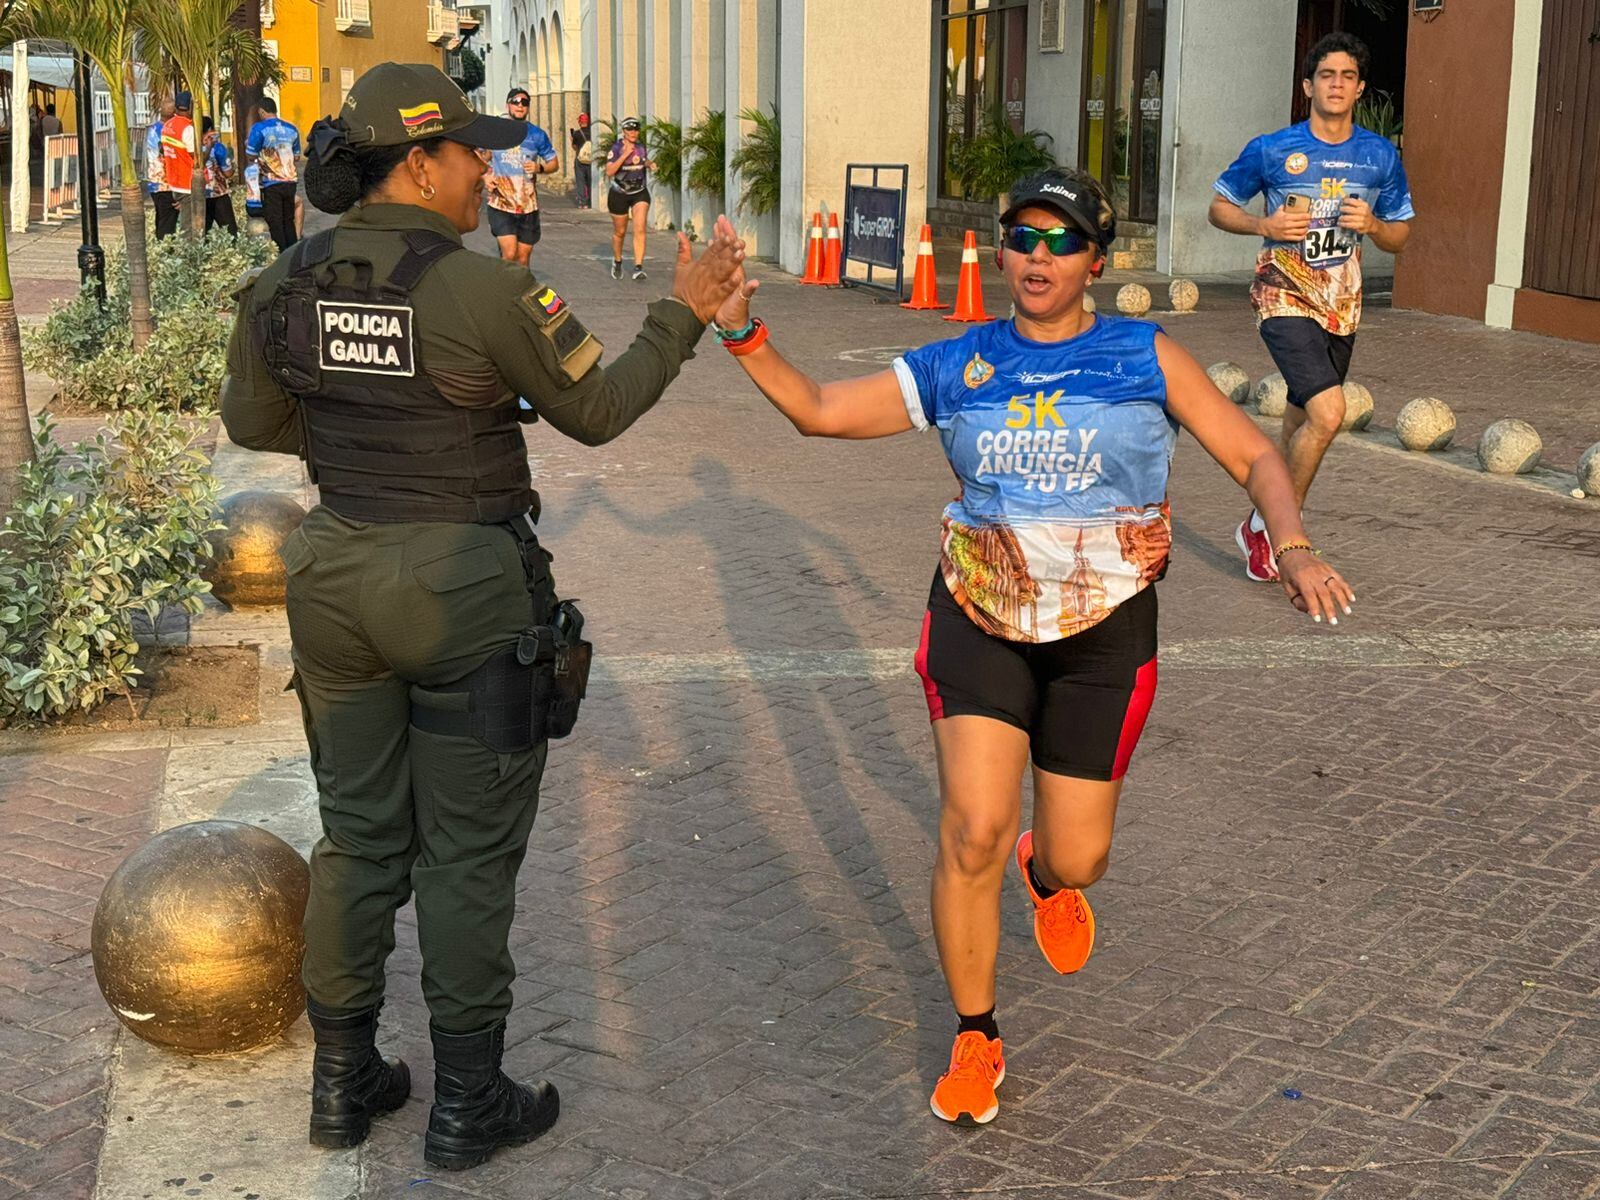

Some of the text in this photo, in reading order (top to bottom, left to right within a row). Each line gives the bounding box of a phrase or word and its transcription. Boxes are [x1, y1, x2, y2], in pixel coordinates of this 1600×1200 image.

[1039, 183, 1077, 201] Selina
[1320, 177, 1348, 199] 5K
[324, 312, 403, 338] POLICIA
[330, 339, 400, 366] GAULA
[1004, 390, 1067, 429] 5K
[976, 428, 1099, 455] CORRE Y
[975, 452, 1102, 480] ANUNCIA
[1022, 473, 1058, 493] TU
